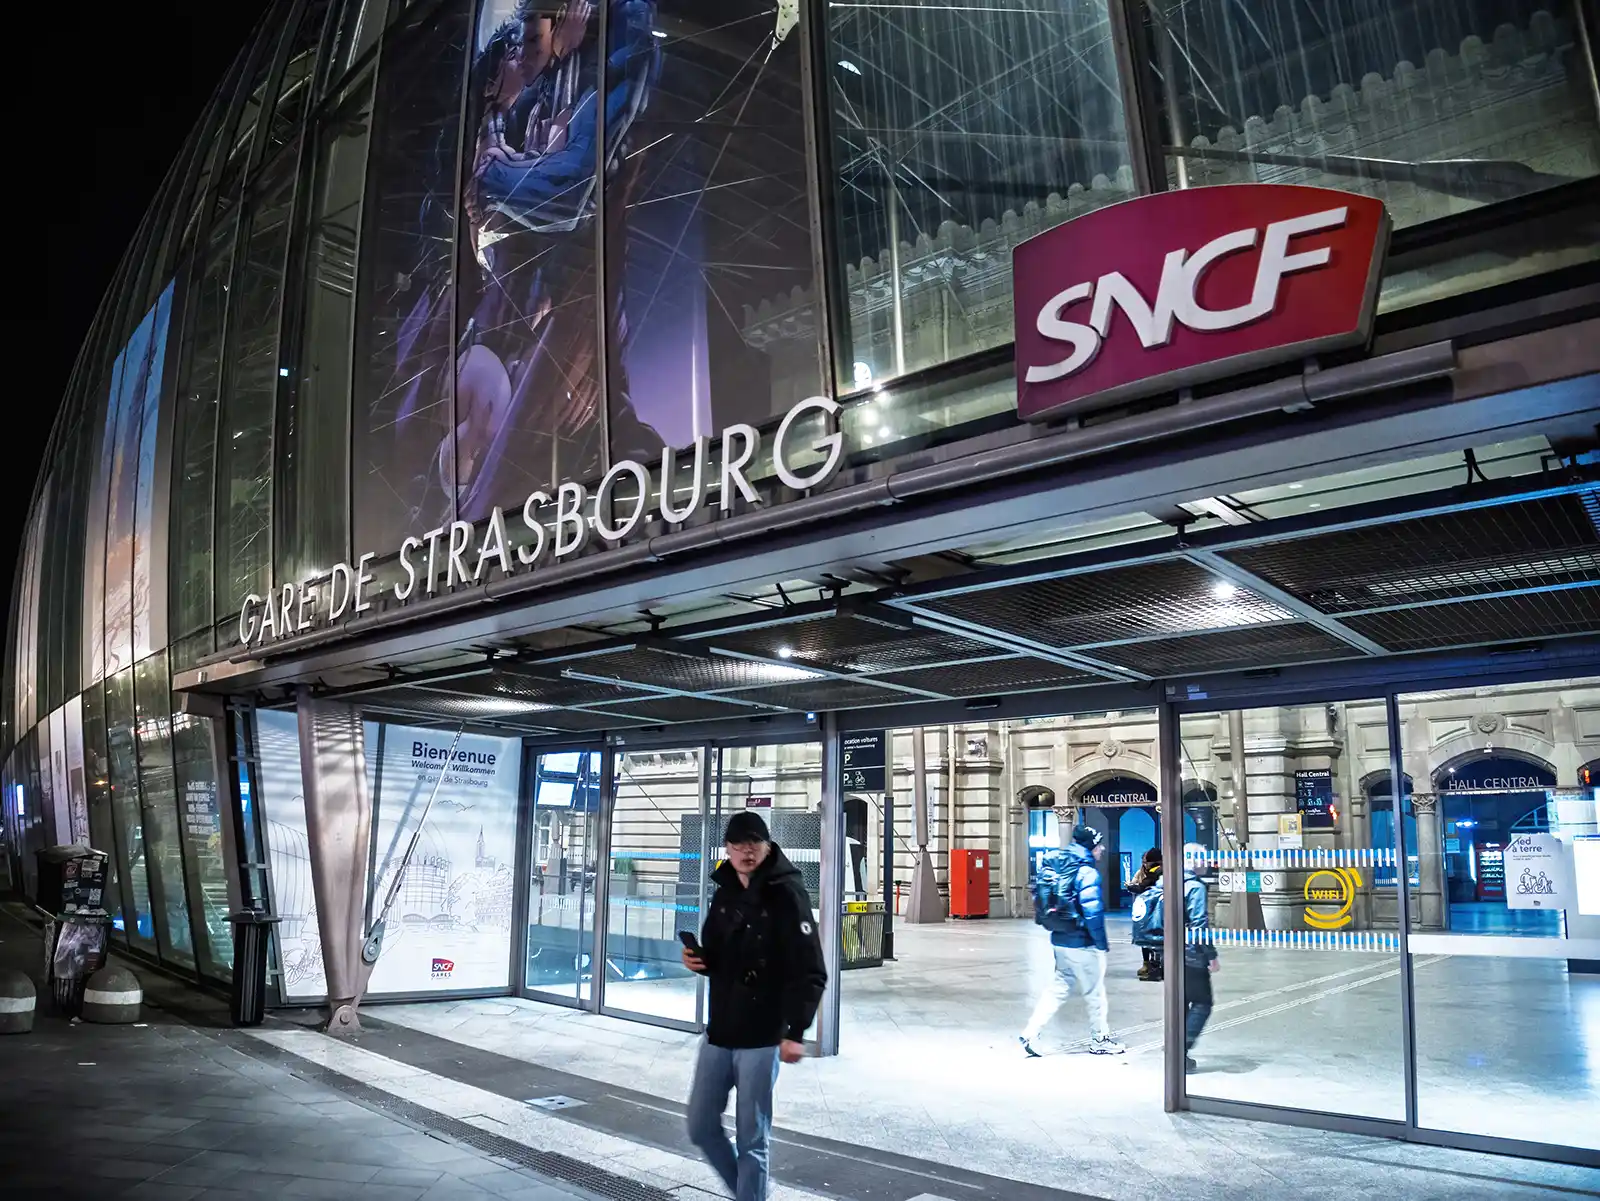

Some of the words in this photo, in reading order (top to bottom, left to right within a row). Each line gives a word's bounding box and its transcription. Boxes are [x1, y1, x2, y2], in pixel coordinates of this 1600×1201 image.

[1024, 205, 1349, 384] SNCF
[239, 580, 319, 645] GARE
[328, 551, 376, 621] DE
[393, 395, 845, 601] STRASBOURG
[412, 742, 496, 764] Bienvenue
[452, 764, 496, 775] Willkommen
[443, 775, 453, 783] de
[454, 776, 488, 788] Strasbourg
[1448, 779, 1481, 790] HALL
[1484, 776, 1544, 789] CENTRAL
[1082, 794, 1107, 804] HALL
[1107, 792, 1151, 804] CENTRAL
[1519, 845, 1543, 853] terre
[1311, 889, 1340, 900] WIFI
[433, 962, 453, 970] SNCF
